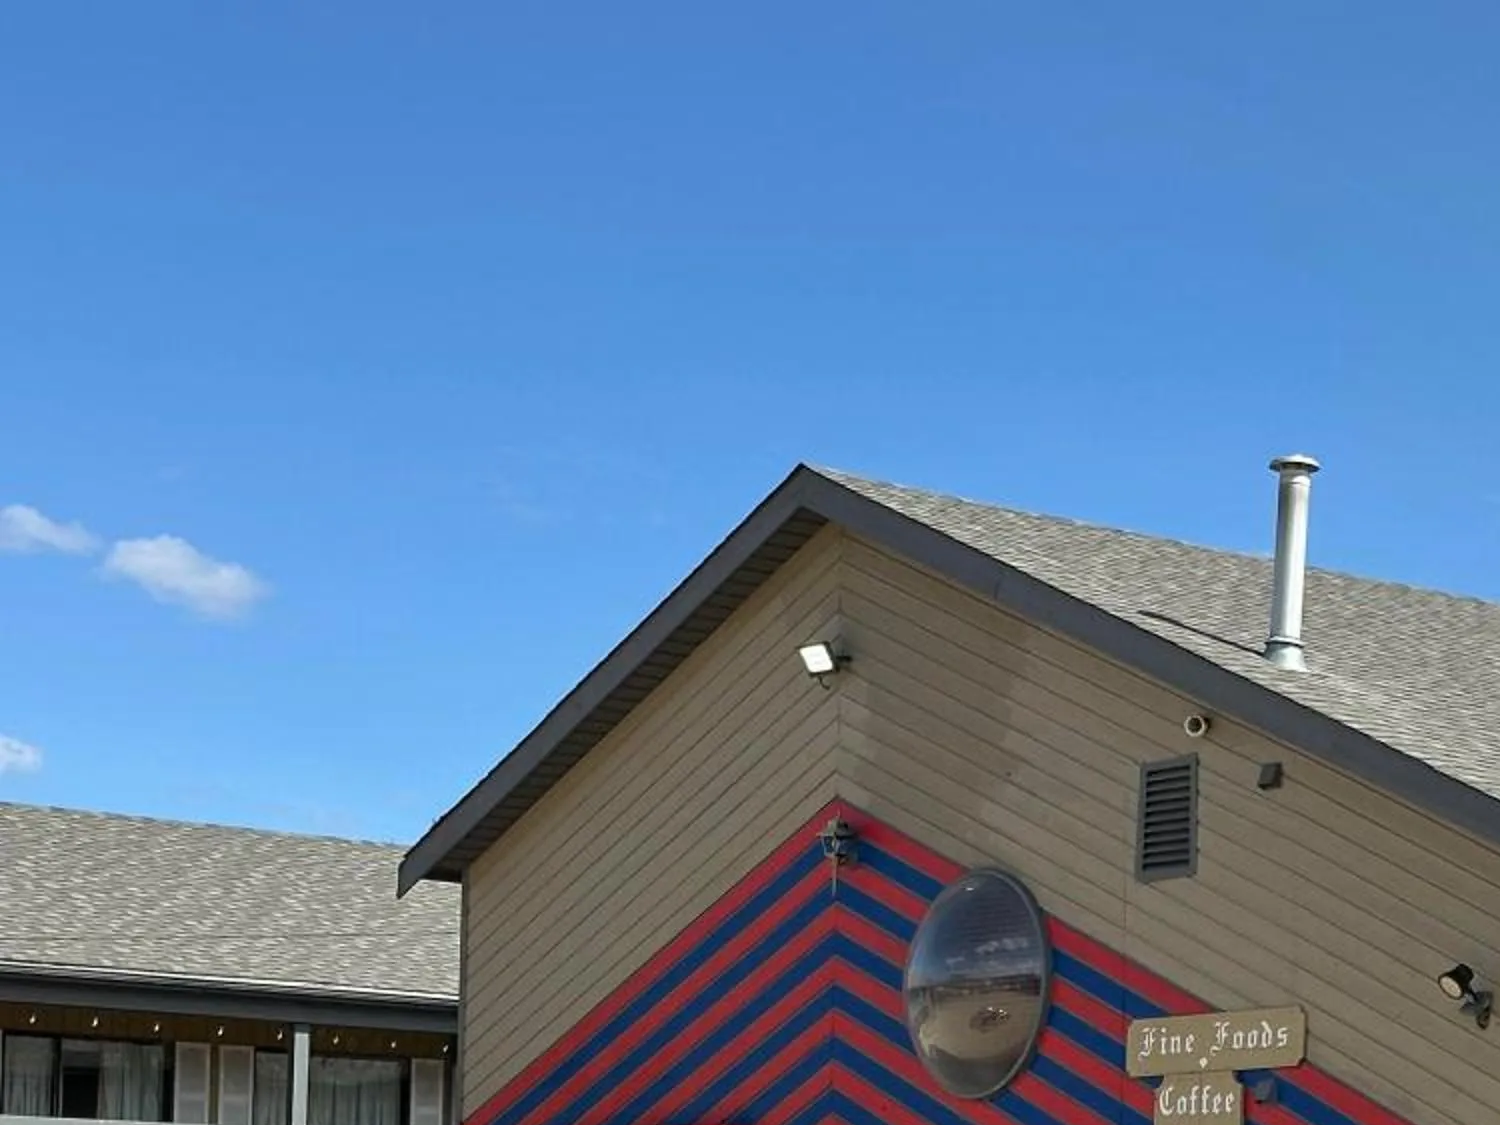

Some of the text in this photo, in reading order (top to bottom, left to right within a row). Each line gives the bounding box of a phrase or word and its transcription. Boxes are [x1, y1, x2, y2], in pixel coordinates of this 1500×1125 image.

[1137, 1020, 1289, 1062] Fine Foods
[1159, 1084, 1235, 1116] Coffee
